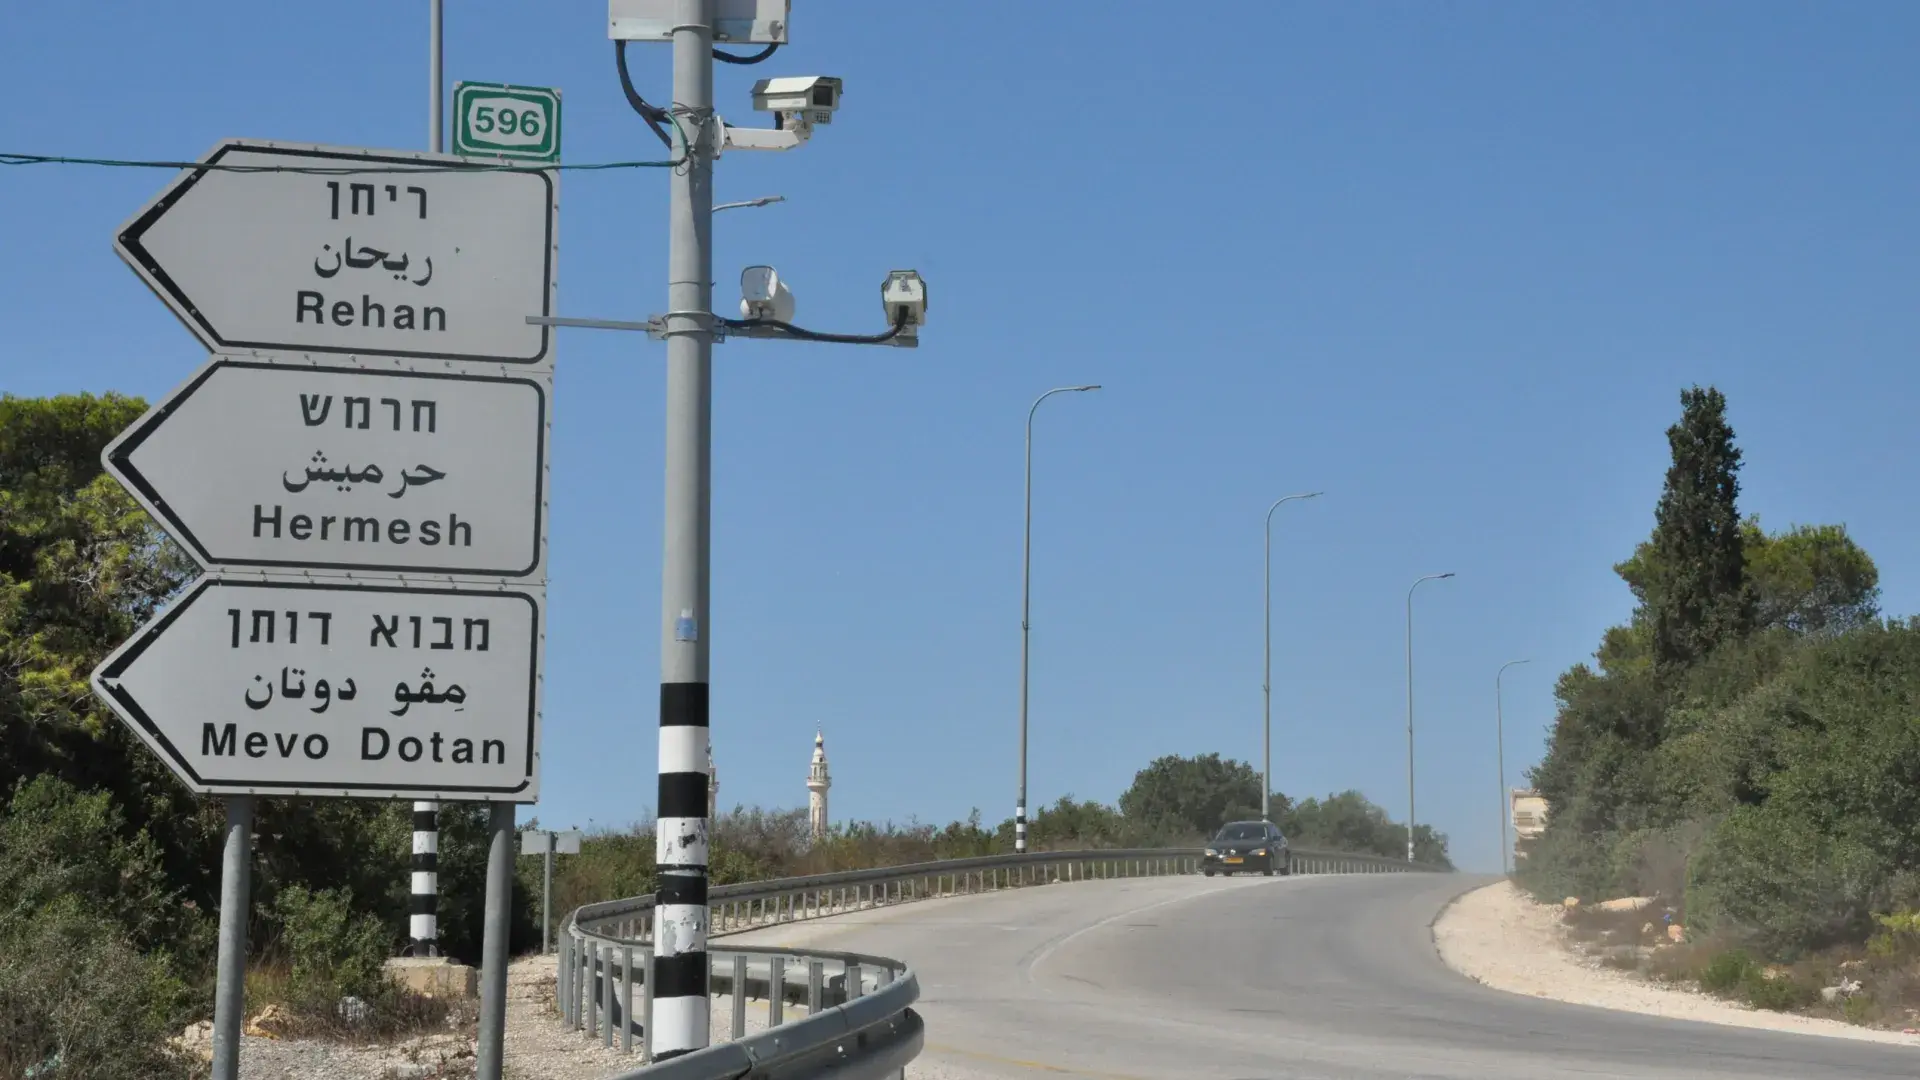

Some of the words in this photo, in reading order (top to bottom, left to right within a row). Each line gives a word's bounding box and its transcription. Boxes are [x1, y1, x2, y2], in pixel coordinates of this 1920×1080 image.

[475, 106, 541, 137] 596
[326, 181, 427, 220] ריחן
[314, 236, 433, 287] ريحان
[296, 291, 446, 331] Rehan
[299, 393, 436, 434] חרמש
[282, 450, 446, 499] حرميش
[253, 504, 472, 547] Hermesh
[227, 608, 332, 649] דותן
[370, 614, 490, 652] מבוא
[244, 666, 357, 714] دوتان
[201, 722, 329, 760] Mevo
[361, 727, 505, 765] Dotan
